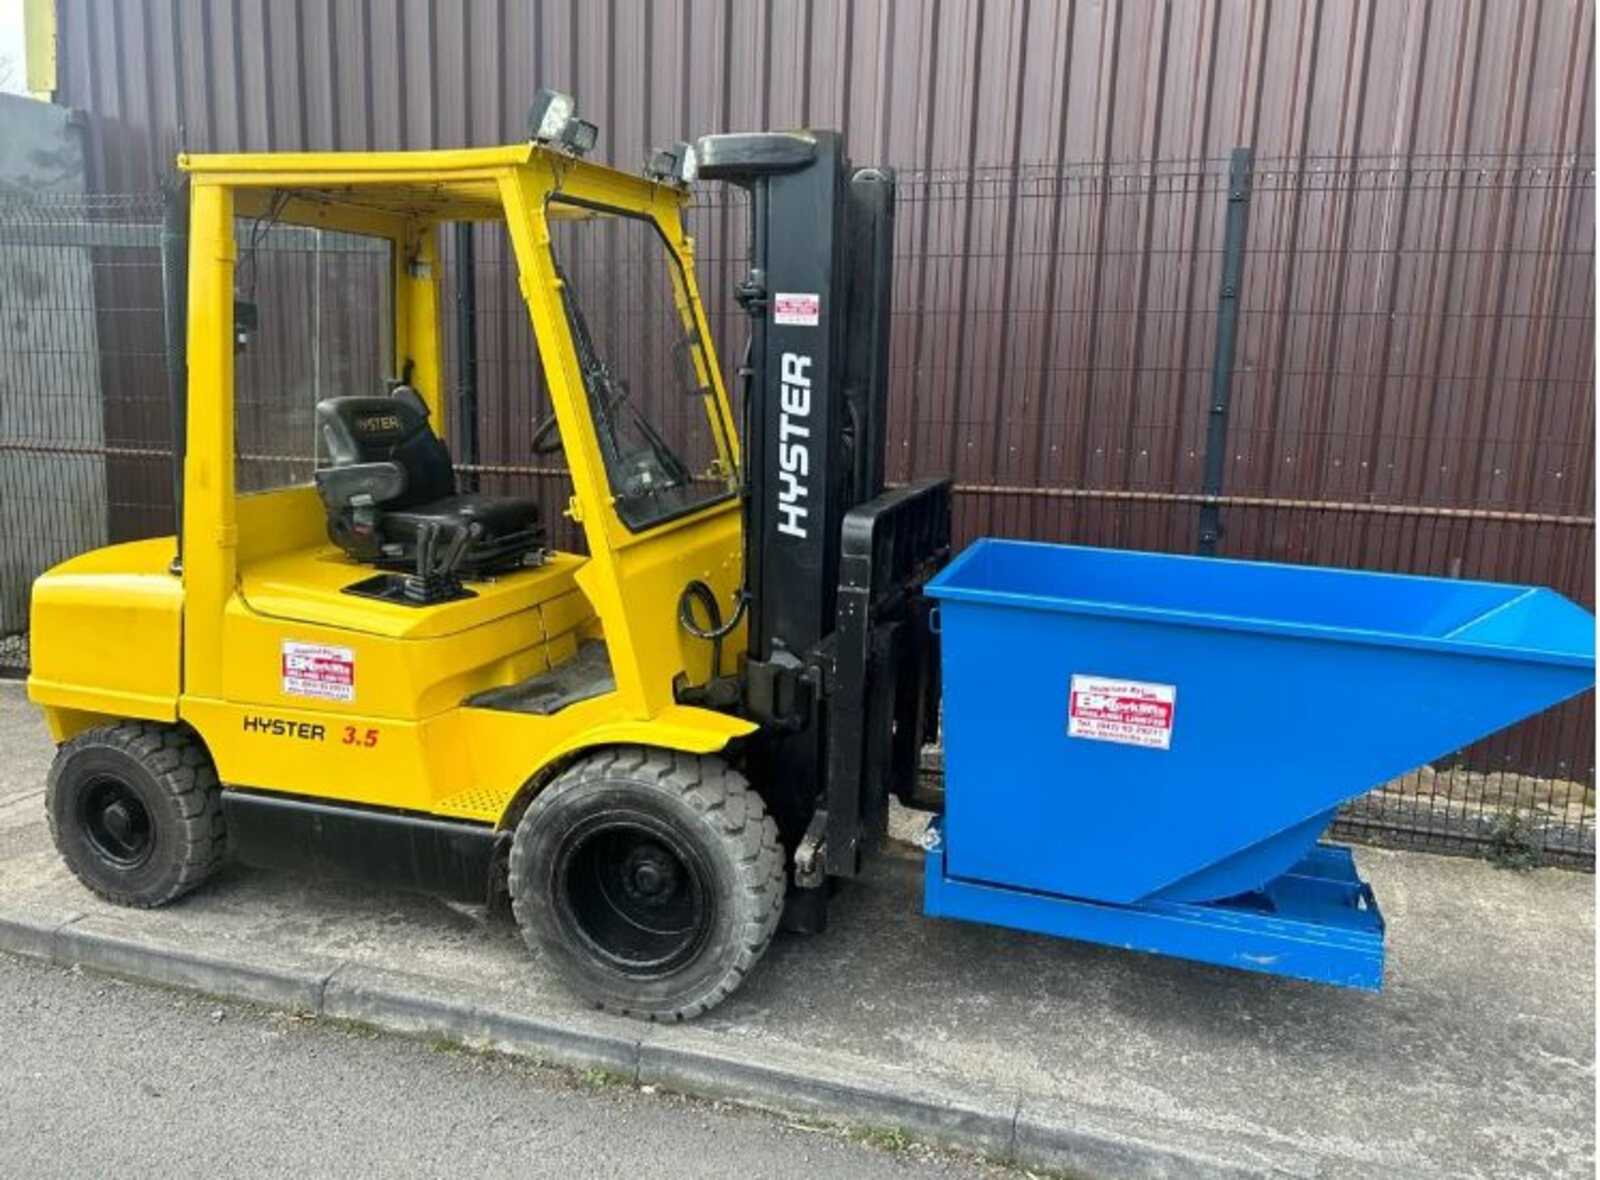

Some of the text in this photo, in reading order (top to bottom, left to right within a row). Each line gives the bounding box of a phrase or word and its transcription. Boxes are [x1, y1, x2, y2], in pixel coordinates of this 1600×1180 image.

[777, 352, 812, 538] HYSTER
[243, 716, 379, 748] HYSTER 3.5
